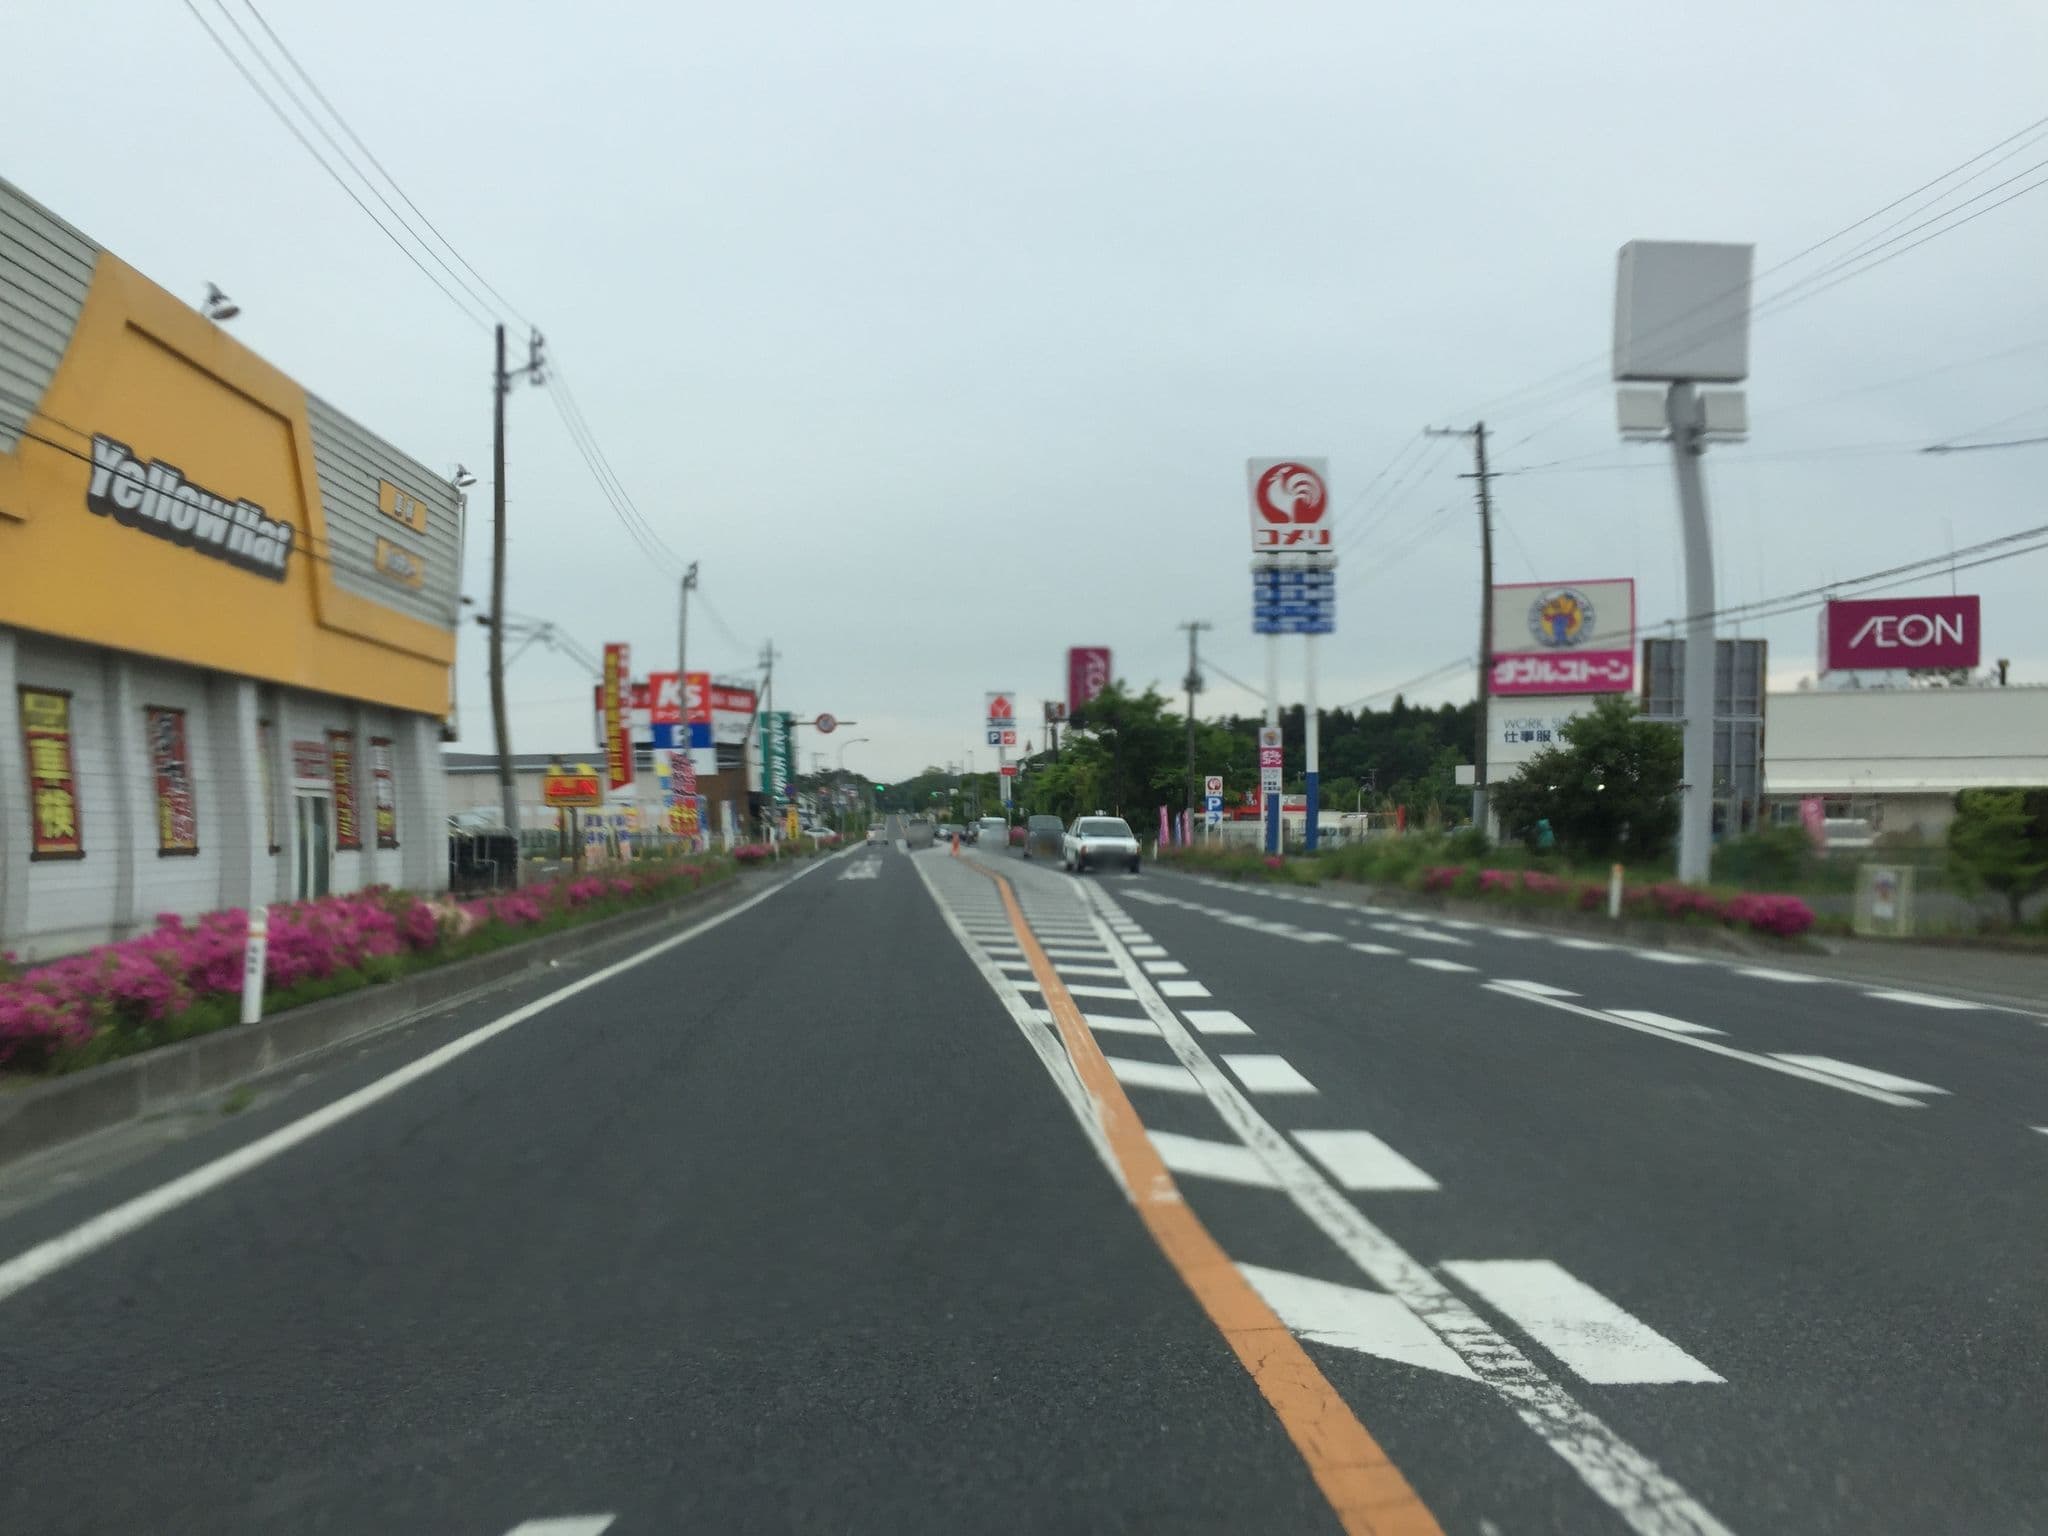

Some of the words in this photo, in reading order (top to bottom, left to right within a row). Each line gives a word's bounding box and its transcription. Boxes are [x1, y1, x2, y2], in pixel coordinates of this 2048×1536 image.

[1256, 528, 1331, 546] コメリ
[1493, 657, 1630, 685] ダブルストーン
[1504, 718, 1543, 729] WORK
[1504, 730, 1551, 743] 仕事服
[1207, 797, 1222, 811] P
